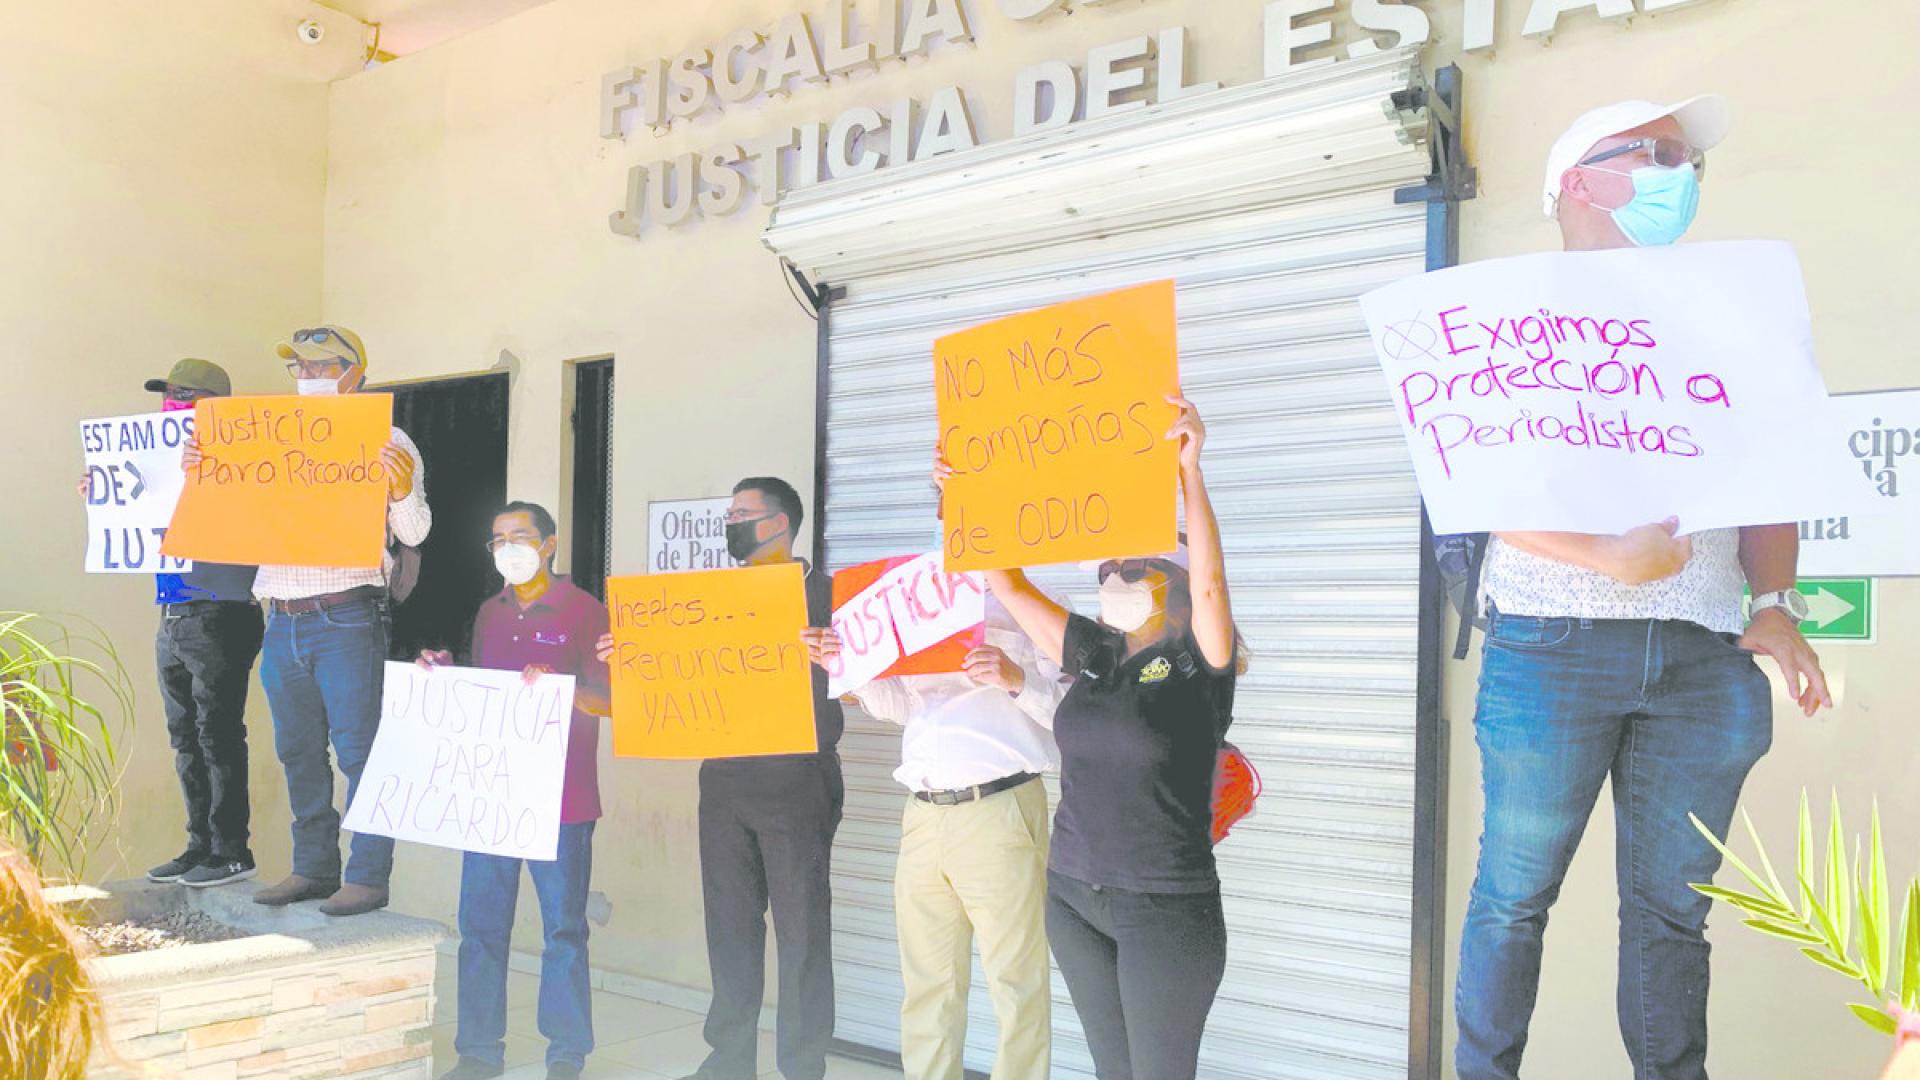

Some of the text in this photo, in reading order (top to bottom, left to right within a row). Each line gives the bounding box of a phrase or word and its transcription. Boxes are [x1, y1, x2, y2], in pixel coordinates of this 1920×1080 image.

[609, 86, 982, 238] JUSTICIA
[1013, 27, 1222, 131] DEL
[1438, 305, 1657, 361] Exigimos
[943, 355, 985, 401] NO
[1686, 374, 1730, 408] a
[199, 404, 332, 447] Justicia
[656, 541, 681, 571] de
[949, 492, 1110, 560] de ODIO
[391, 673, 564, 755] JUSTICIA
[428, 736, 512, 802] PARA
[369, 773, 537, 849] RICARDO
